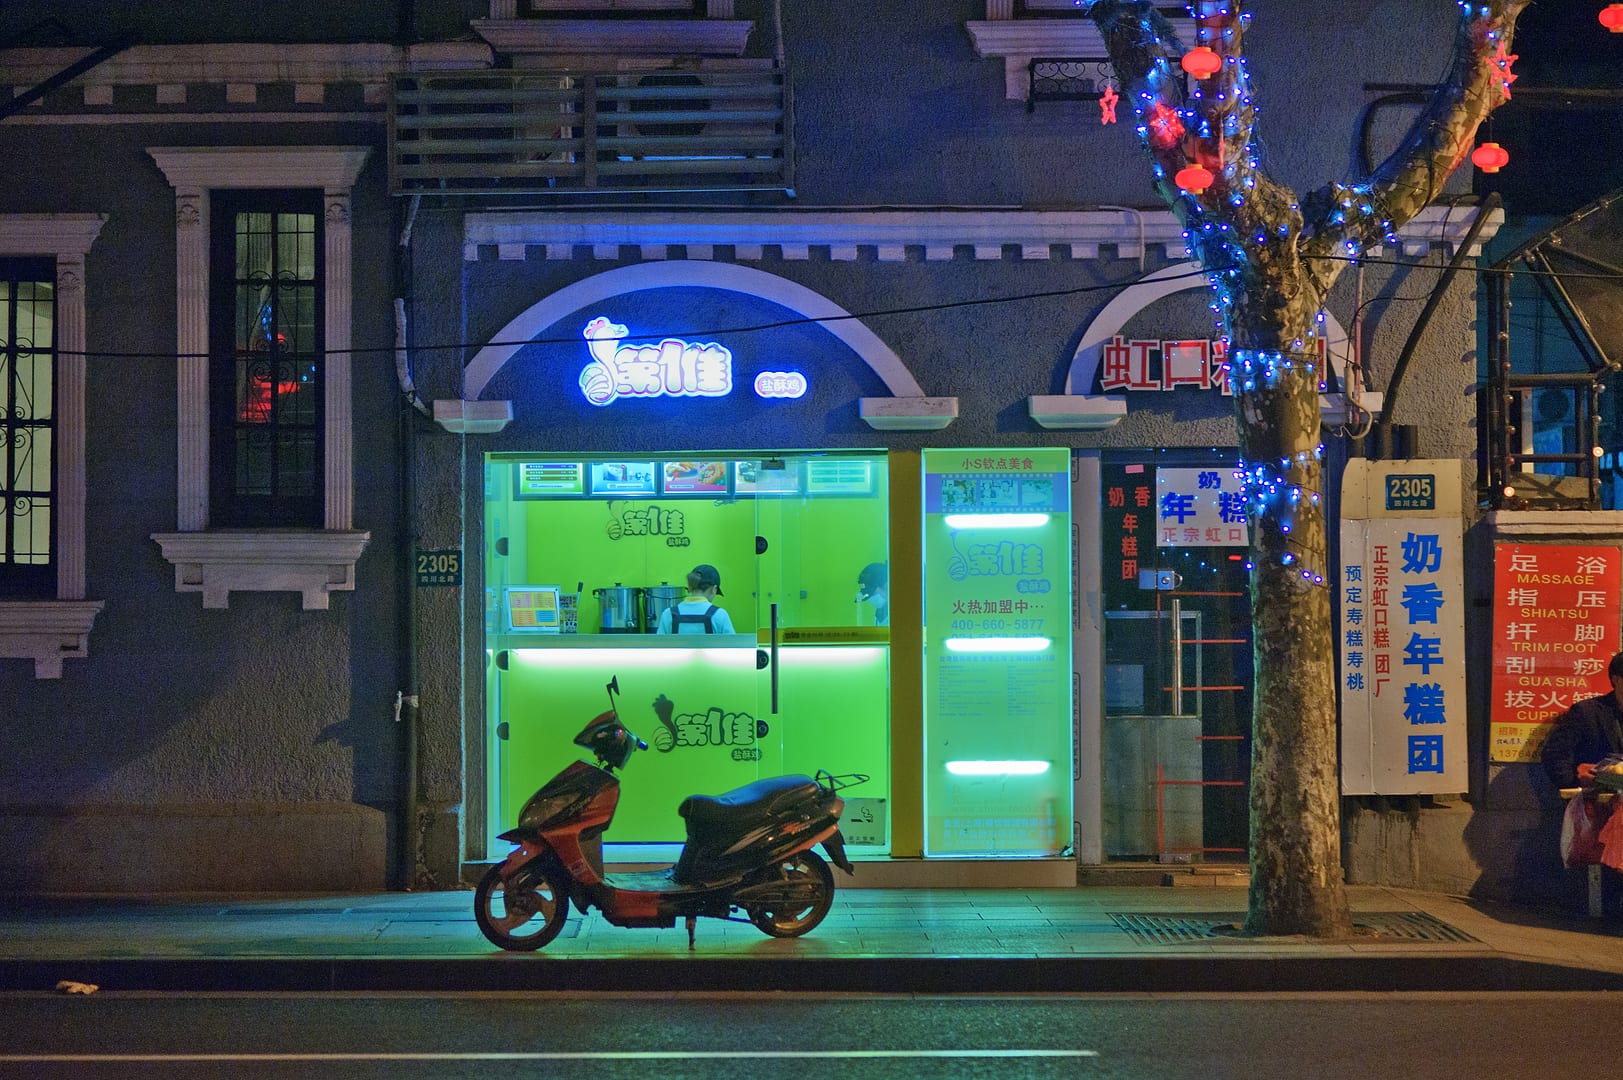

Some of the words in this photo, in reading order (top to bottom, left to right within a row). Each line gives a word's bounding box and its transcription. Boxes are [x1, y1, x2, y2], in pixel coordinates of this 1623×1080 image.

[961, 457, 1034, 470] 小S钦点美食
[1390, 478, 1432, 498] 2305
[1162, 527, 1242, 543] 正宗虹口
[1121, 513, 1139, 580] 年糕团
[417, 554, 459, 573] 2305
[1517, 574, 1595, 585] MASSAGE
[1521, 608, 1589, 619] SHIATSU
[951, 618, 1045, 630] 400-660-5877
[1345, 565, 1365, 691] 预定寿糕寿桃
[1372, 545, 1391, 698] 正宗虹口糕团厂
[1400, 532, 1447, 775] 奶香年糕团
[1512, 642, 1550, 653] TRIM
[1554, 643, 1597, 653] FOOT
[1519, 677, 1552, 687] GUA
[1556, 678, 1588, 688] SHA
[1516, 710, 1562, 721] CUPP
